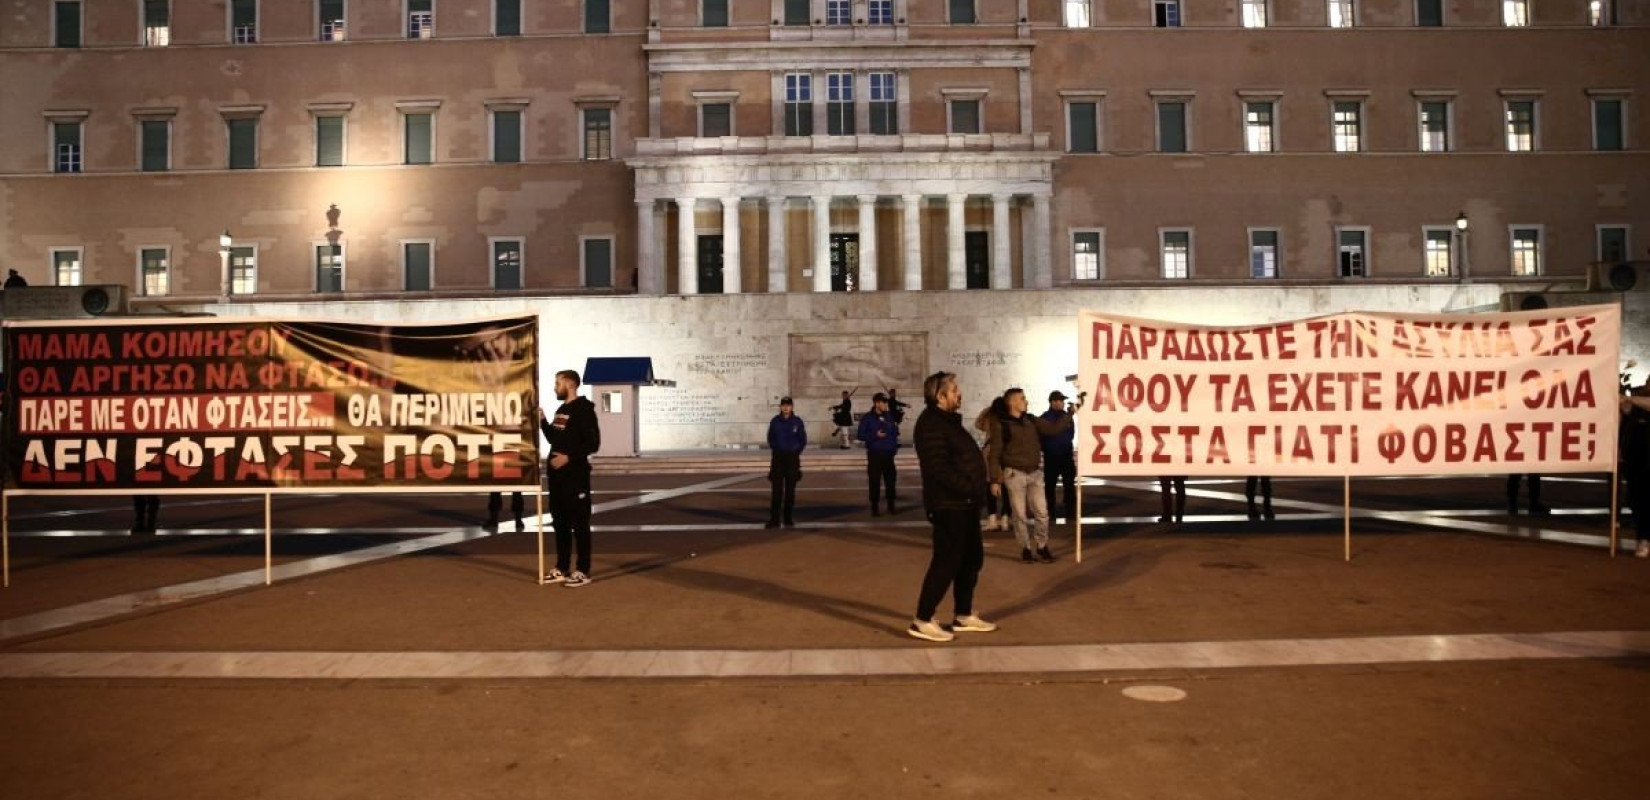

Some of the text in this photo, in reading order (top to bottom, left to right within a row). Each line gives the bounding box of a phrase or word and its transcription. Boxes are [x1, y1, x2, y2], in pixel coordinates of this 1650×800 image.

[18, 329, 290, 360] ΜΑΜΑ ΚΟΙΜΗΣΟΥ
[1092, 317, 1596, 361] ΠΑΡΑΔΩΣΤΕ ΤΗΝ ΑΣΥΛΙΑ ΣΑΣ
[18, 366, 61, 393] ΘΑ
[70, 363, 195, 392] ΑΡΓΗΣΩ
[205, 362, 249, 390] ΝΑ
[1091, 369, 1596, 413] ΑΦΟΥ ΤΑ ΕΧΕΤΕ ΚΑΝΕΙ ΟΛΑ
[21, 392, 522, 431] ΠΑΡΕ ΜΕ ΟΤΑΝ ΦΤΑΣΕΙΣ... ΘΑ ΠΕΡΙΜΕΝΩ
[22, 433, 522, 482] ΔΕΝ ΕΦΤΑΣΕΣ ΠΟΤΕ
[1091, 421, 1596, 464] ΣΩΣΤΑ ΓΙΑΤΙ ΦΟΒΑΣΤΕ;
